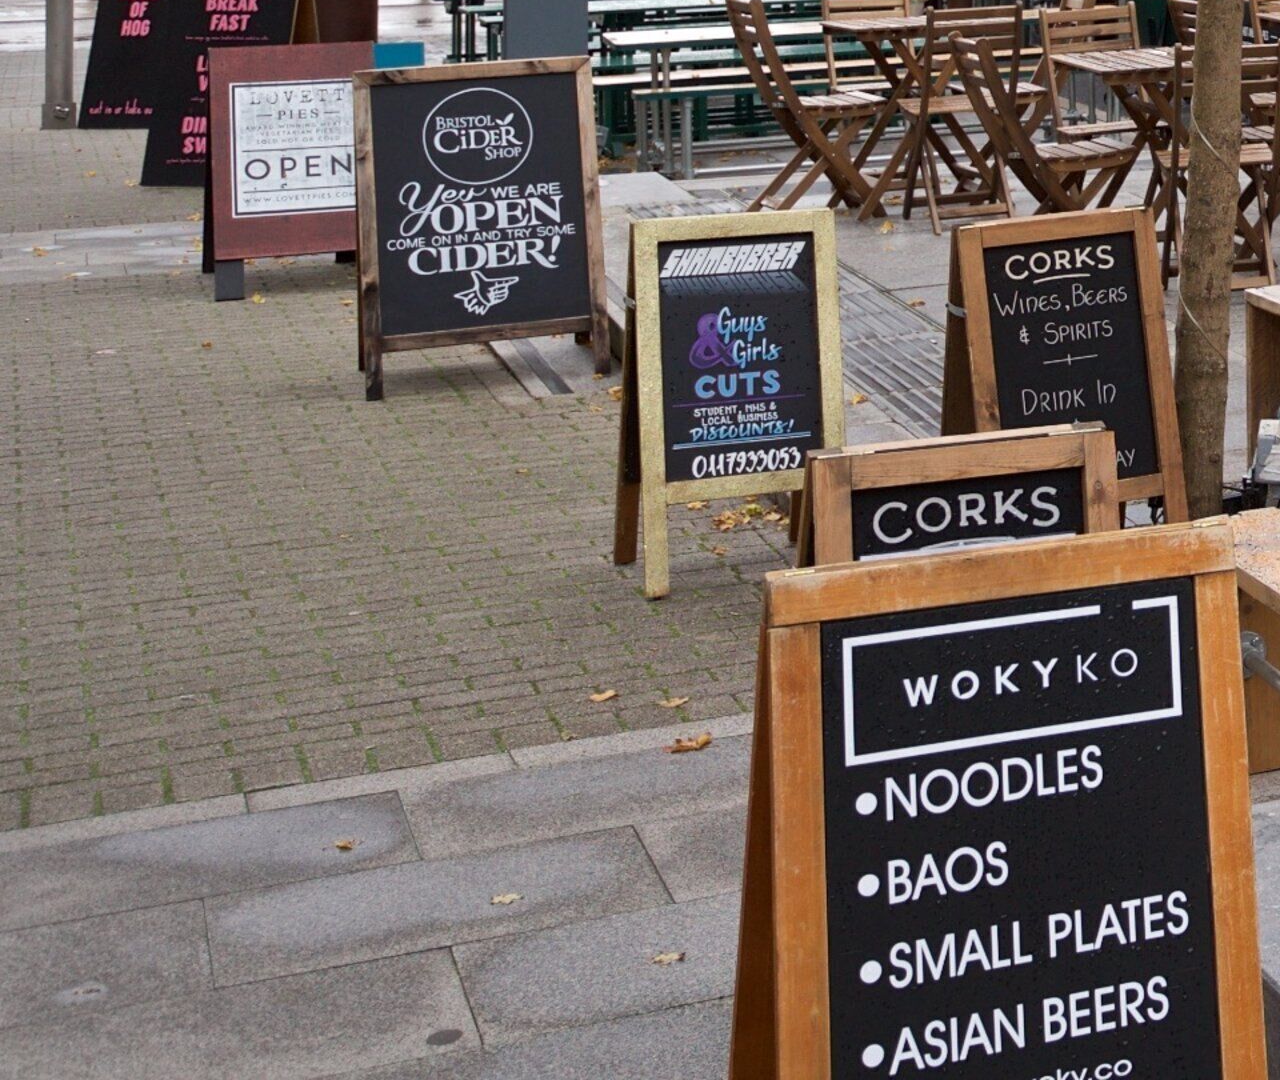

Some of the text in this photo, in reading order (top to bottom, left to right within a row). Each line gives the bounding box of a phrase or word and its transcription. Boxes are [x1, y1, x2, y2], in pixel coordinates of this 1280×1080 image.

[129, 1, 149, 18] OF
[209, 14, 251, 31] FAST
[120, 20, 151, 36] HOG
[250, 88, 345, 105] LOVETT
[277, 108, 320, 120] PIES
[435, 115, 496, 131] BRISTOL
[244, 153, 353, 180] OPEN
[484, 146, 523, 161] SHOP
[490, 185, 520, 199] WE
[524, 182, 562, 196] ARE
[431, 194, 564, 234] OPEN
[387, 223, 577, 251] COME ON IN AND TRY SOME
[407, 235, 561, 276] CIDER!
[1004, 244, 1116, 281] CORKS
[1071, 283, 1128, 309] BEERS
[717, 306, 769, 344] Guys
[1019, 319, 1114, 346] & SPIRITS
[732, 337, 783, 369] Girls
[694, 369, 781, 399] CUTS
[744, 402, 767, 413] NHS
[769, 401, 777, 410] &
[1021, 387, 1086, 417] DRINK
[688, 418, 795, 443] DISCOUNTS!
[701, 411, 778, 427] LOCAL BUSINESS
[691, 446, 801, 478] 0117933053
[872, 486, 1061, 544] CORKS
[885, 744, 1104, 822] NOODLES
[886, 840, 1009, 905] BAOS
[887, 890, 1190, 989] SMALL PLATES
[888, 975, 1170, 1076] ASIAN BEERS
